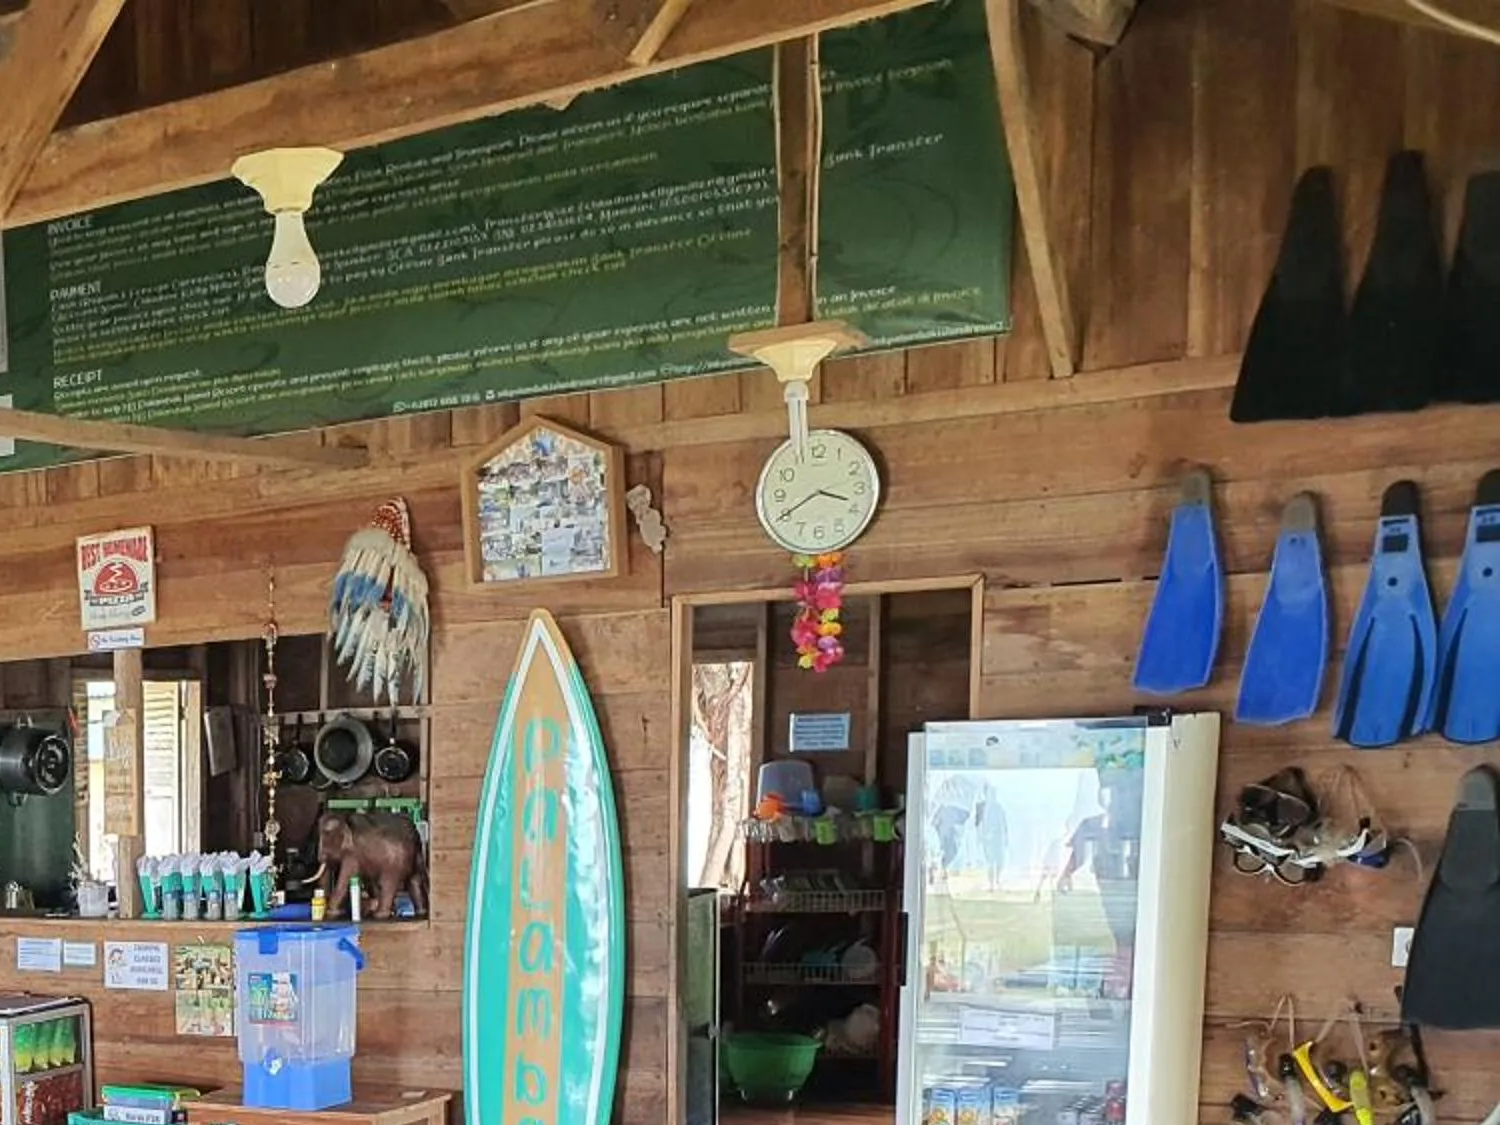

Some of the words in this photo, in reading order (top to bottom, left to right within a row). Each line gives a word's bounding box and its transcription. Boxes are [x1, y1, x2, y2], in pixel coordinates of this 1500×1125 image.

[866, 135, 943, 159] Transfer
[849, 285, 897, 303] Invoice
[288, 374, 308, 385] and
[542, 336, 562, 347] any
[582, 328, 611, 343] your
[671, 316, 693, 326] are
[721, 304, 771, 319] written
[53, 368, 102, 389] RECEIPT
[812, 443, 827, 459] 12
[780, 467, 795, 482] 10
[848, 461, 860, 476] 2
[774, 488, 786, 502] 9
[854, 482, 865, 495] 3
[796, 521, 806, 536] 7
[814, 525, 825, 540] 6
